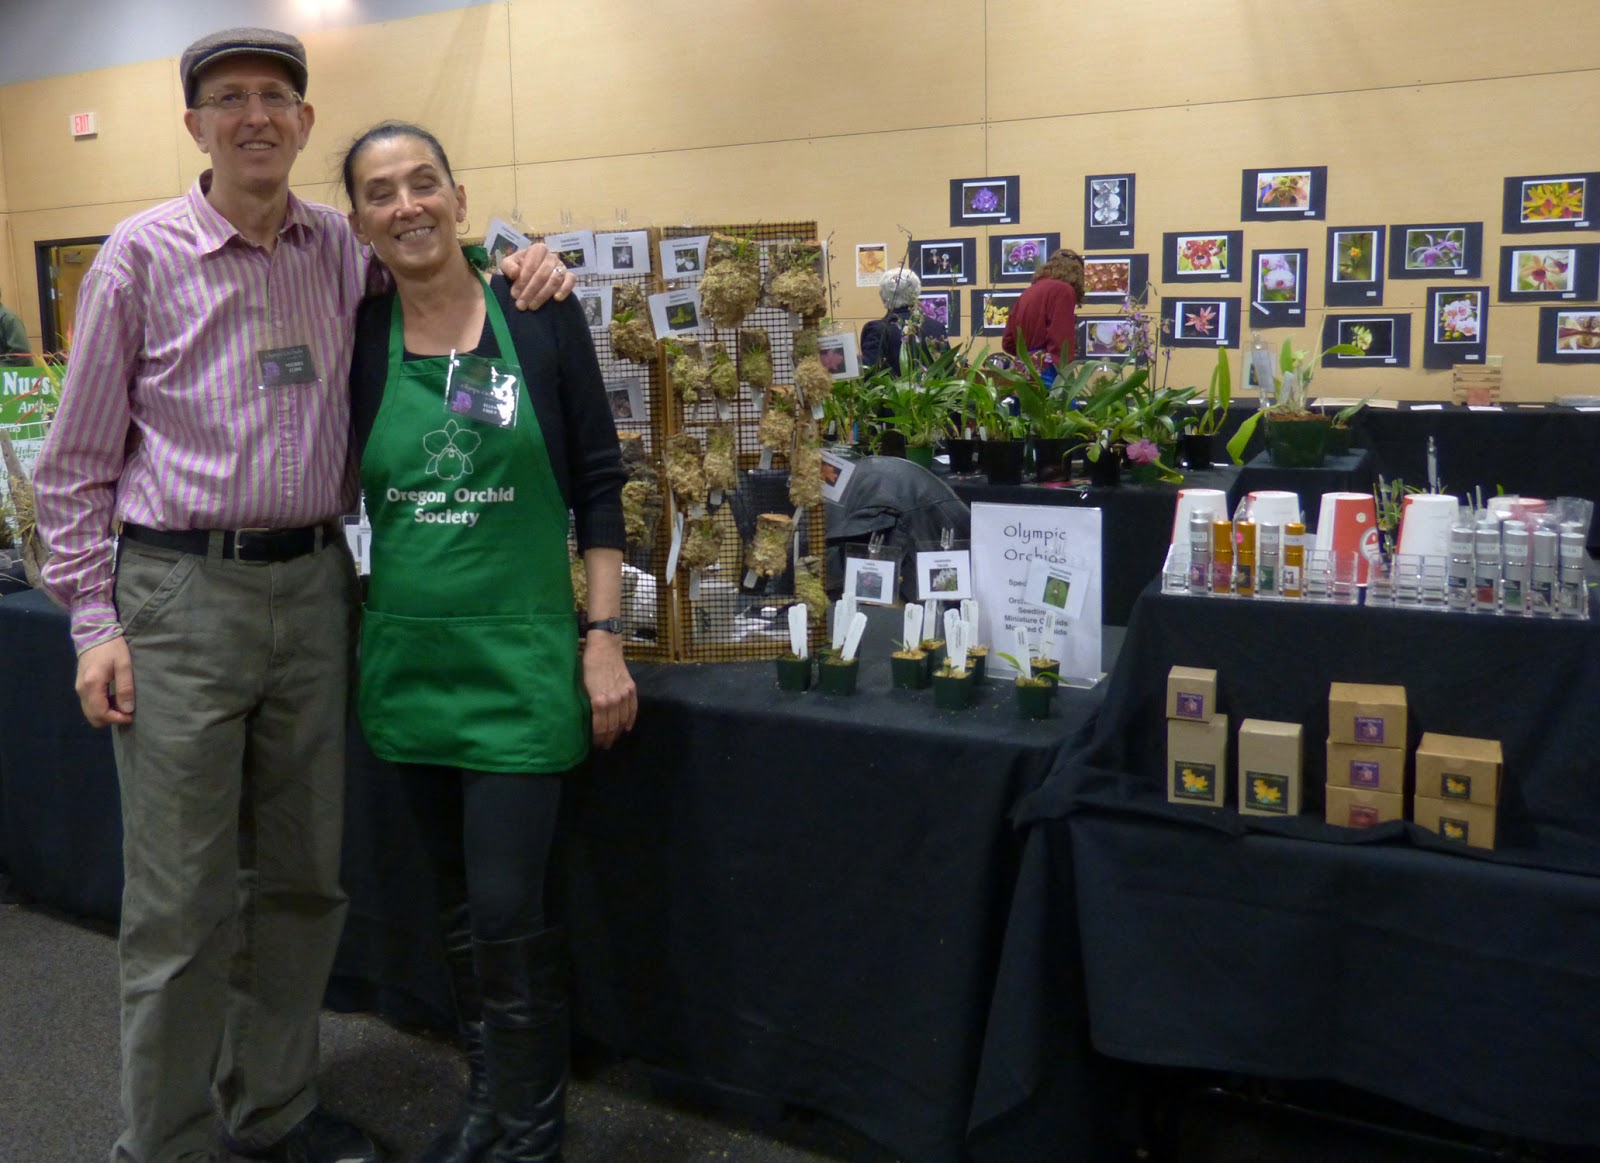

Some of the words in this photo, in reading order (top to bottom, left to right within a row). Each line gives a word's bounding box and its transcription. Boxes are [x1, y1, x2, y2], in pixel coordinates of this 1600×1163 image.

[75, 114, 90, 133] EXIT
[386, 487, 447, 506] Oregon
[454, 486, 515, 503] Orchid
[414, 507, 480, 527] Society
[1003, 521, 1067, 546] Olympic
[1004, 614, 1038, 625] Miniature
